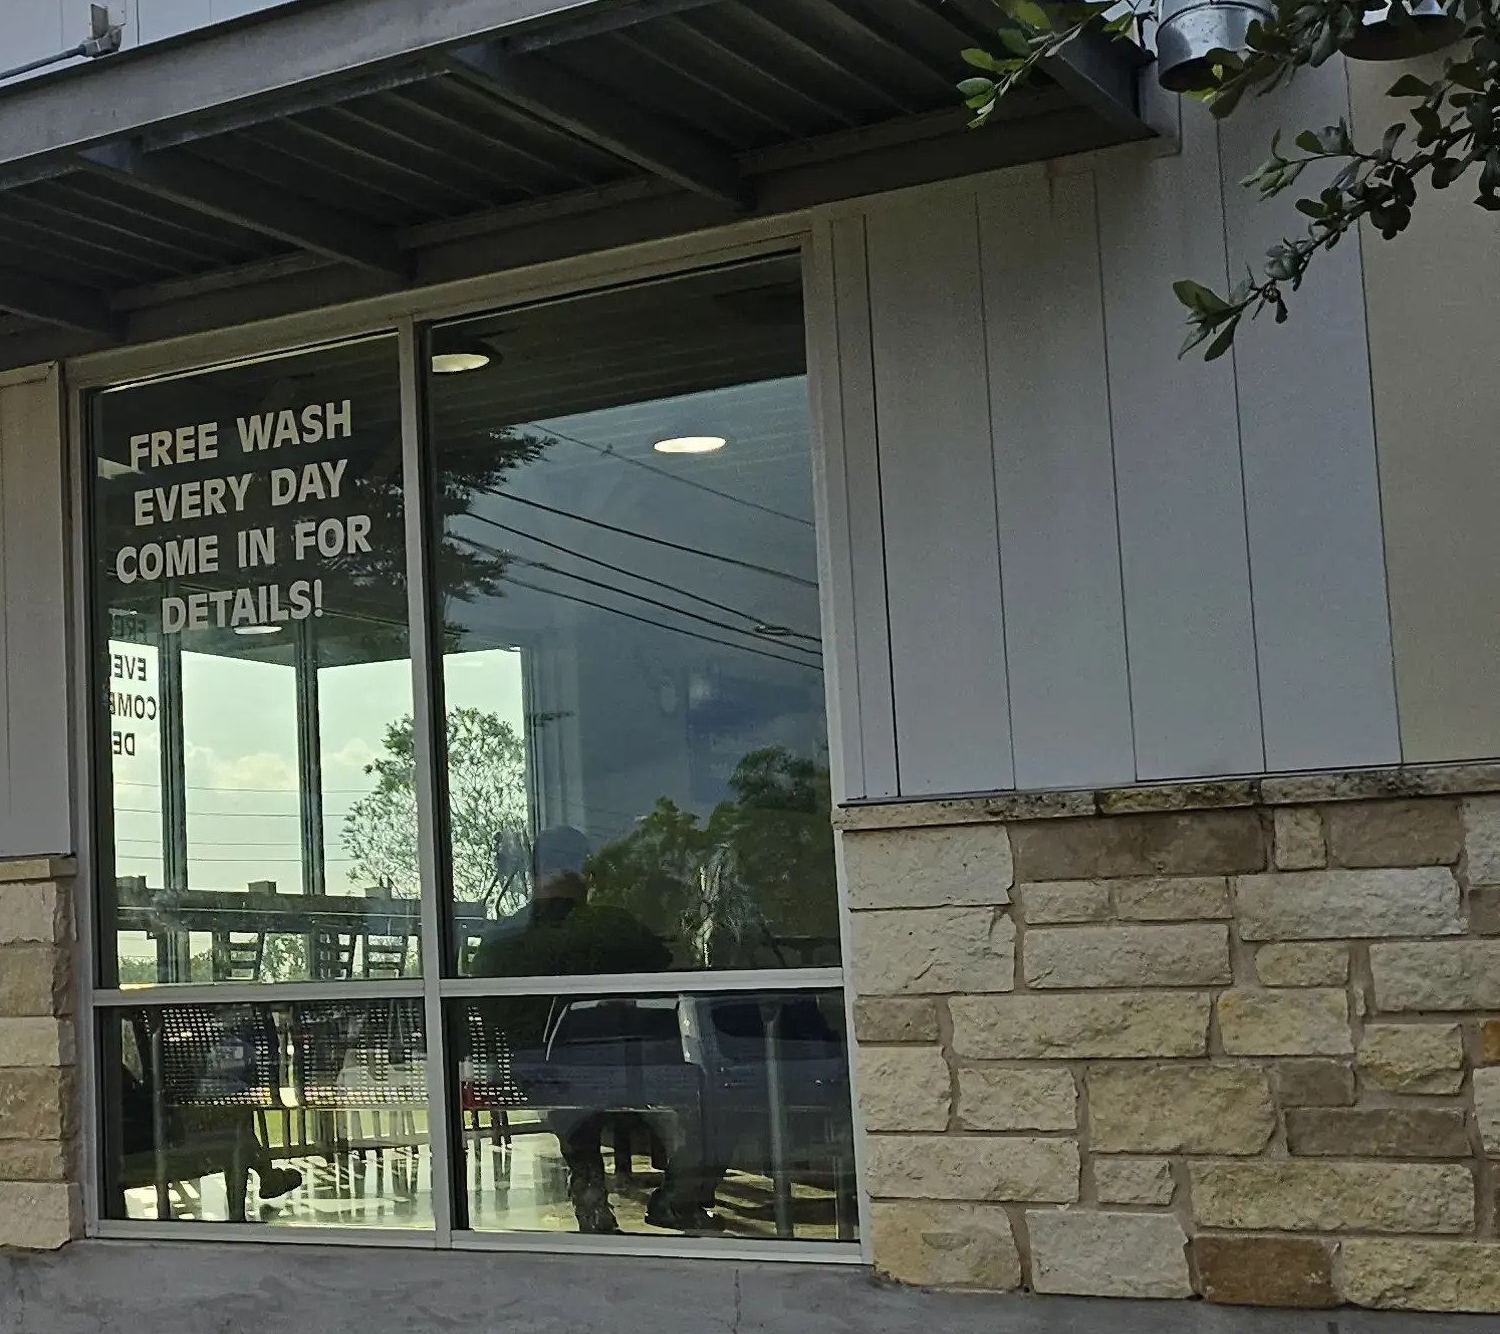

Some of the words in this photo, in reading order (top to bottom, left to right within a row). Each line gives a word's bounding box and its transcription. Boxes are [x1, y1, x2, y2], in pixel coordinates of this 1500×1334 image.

[129, 422, 219, 468] FREE
[237, 399, 353, 453] WASH
[134, 473, 253, 526] EVERY
[271, 459, 349, 507] DAY
[115, 535, 219, 584] COME
[237, 527, 276, 568] IN
[295, 514, 373, 561] FOR
[162, 579, 323, 635] DETAILS!
